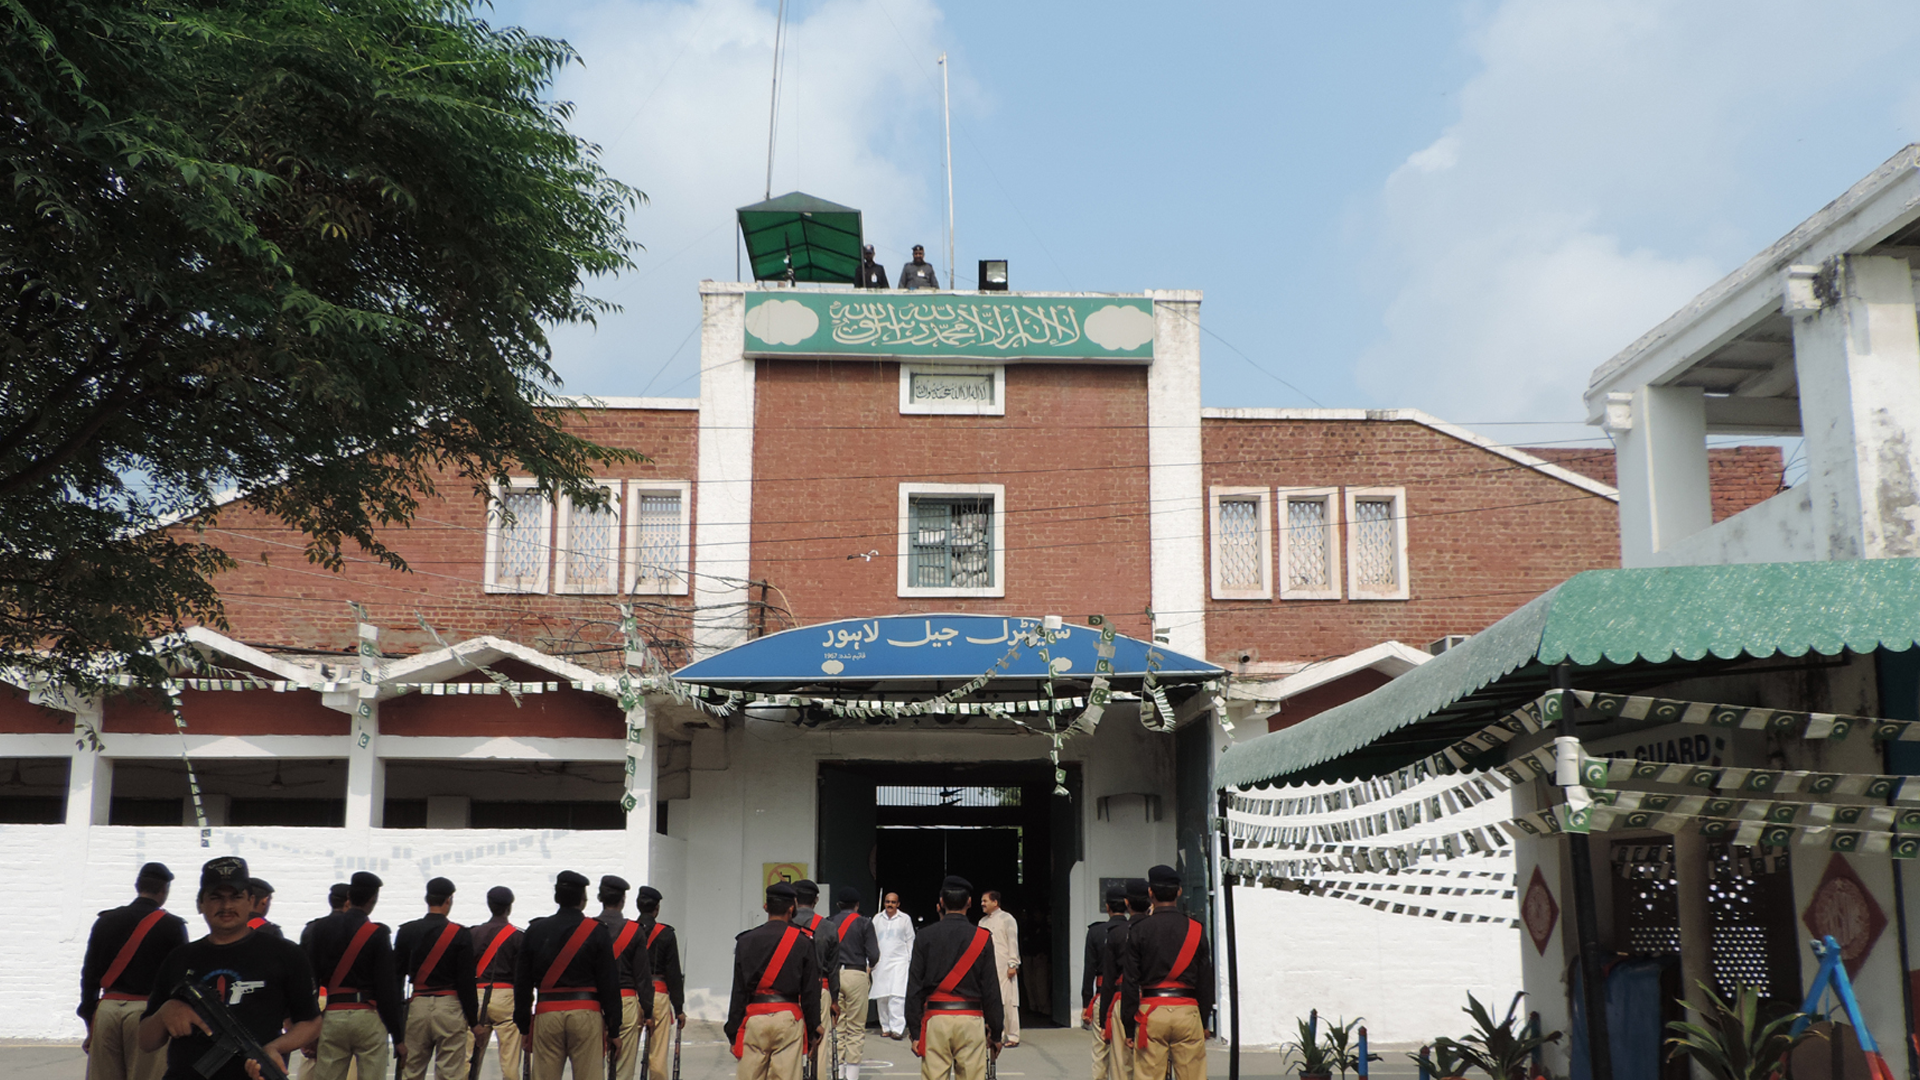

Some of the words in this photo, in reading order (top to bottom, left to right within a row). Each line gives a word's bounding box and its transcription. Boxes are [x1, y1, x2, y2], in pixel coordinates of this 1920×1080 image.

[822, 620, 879, 650] لاہور
[887, 620, 959, 647] جیل
[1634, 734, 1711, 764] GUARD
